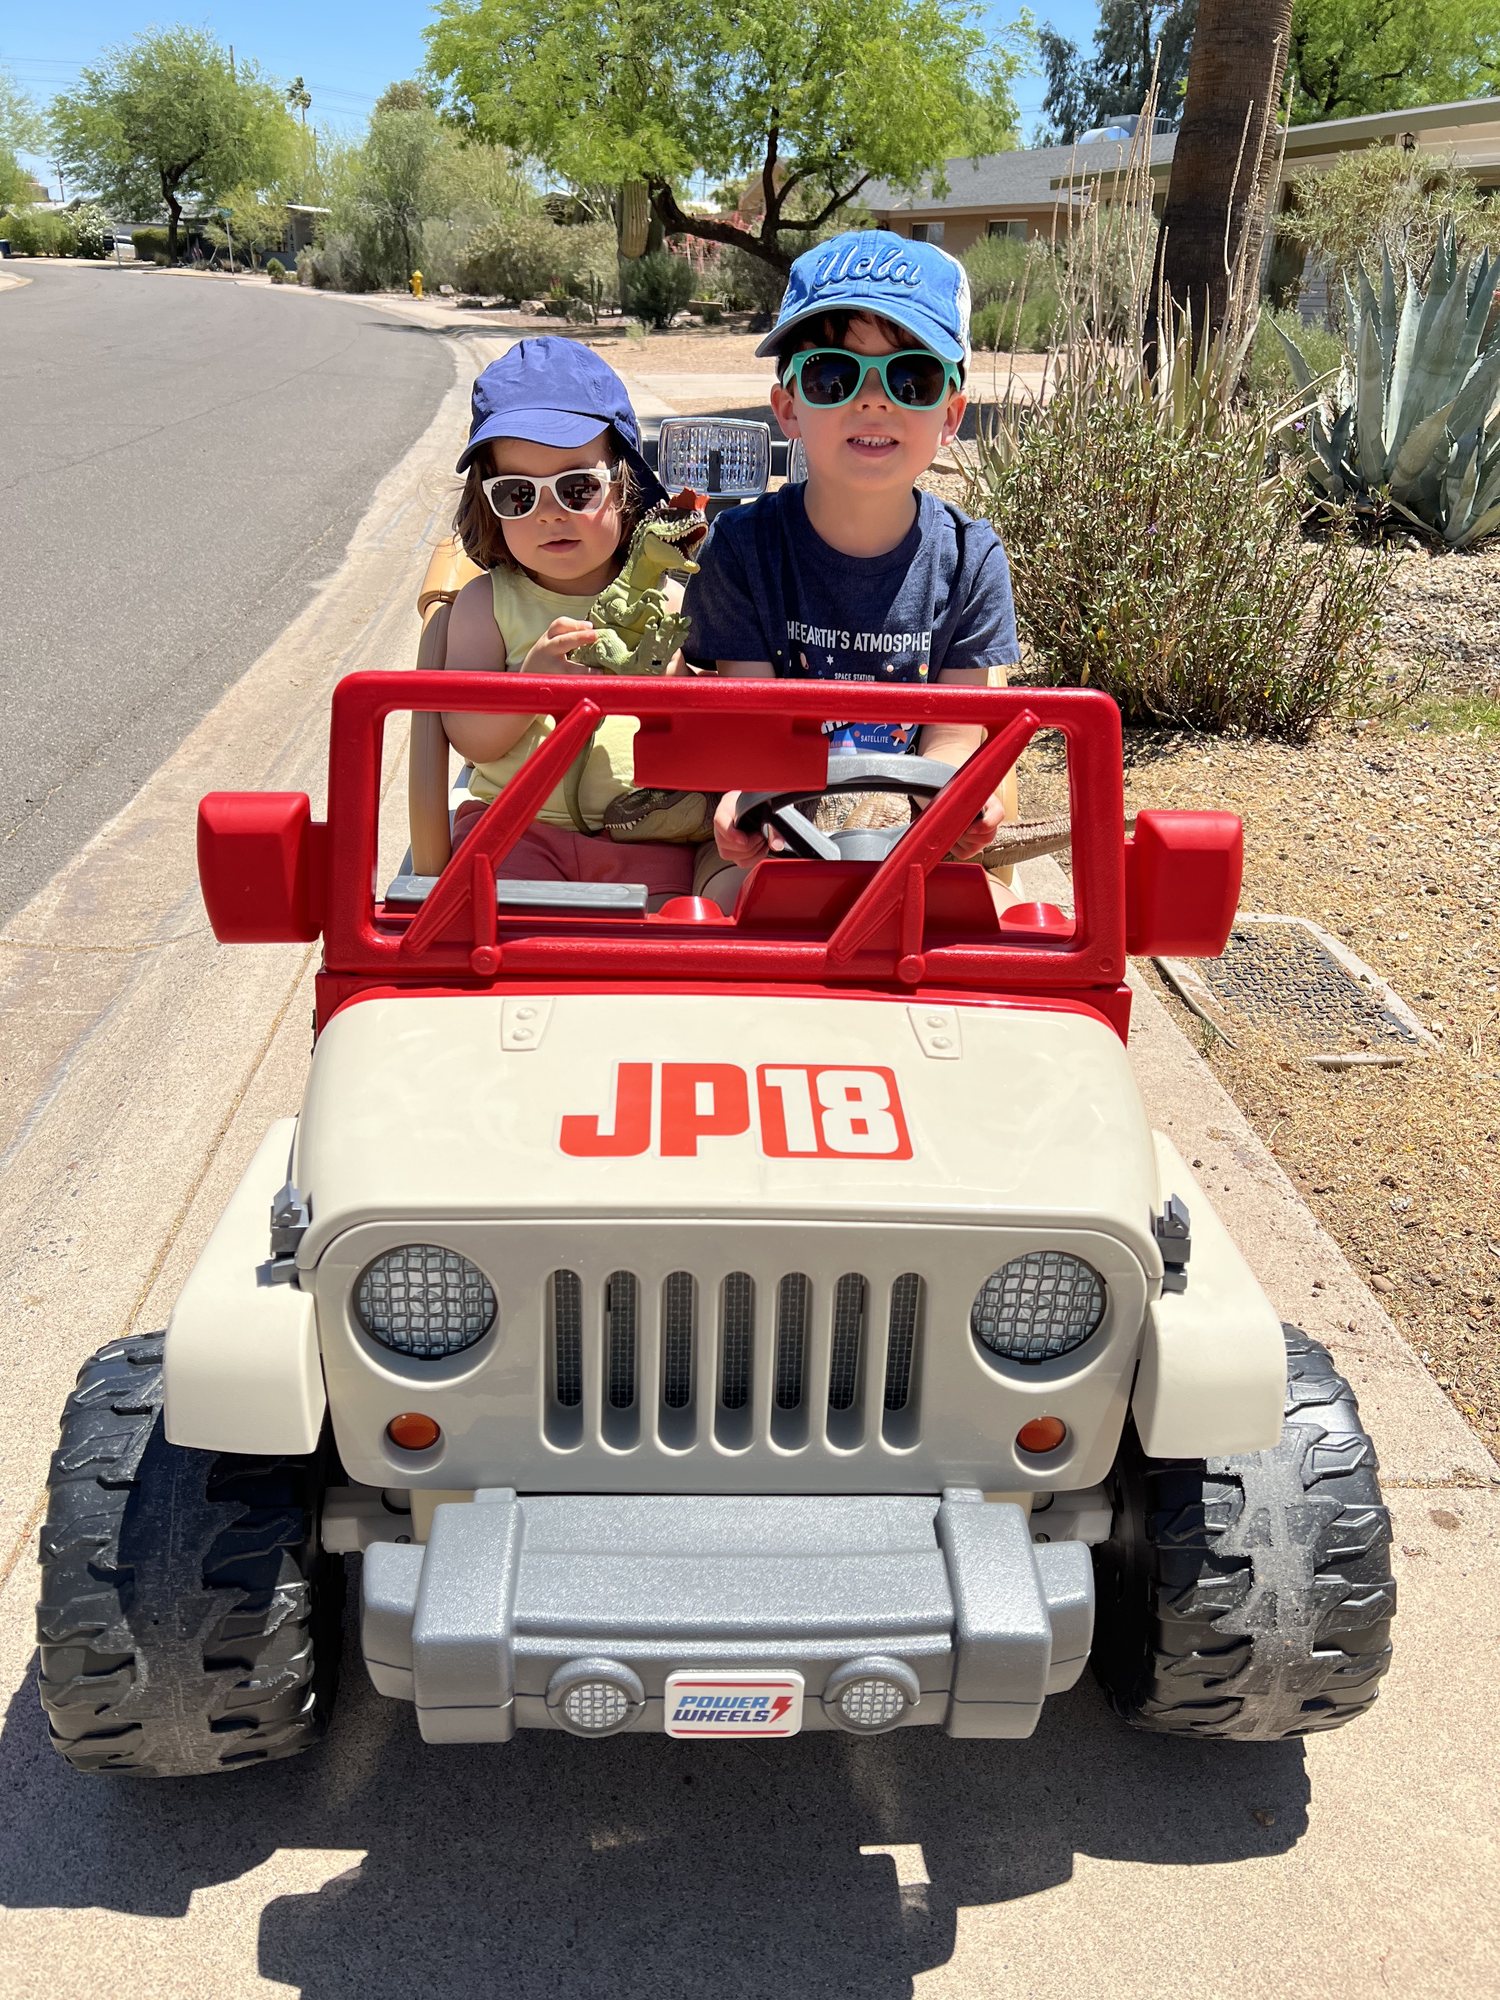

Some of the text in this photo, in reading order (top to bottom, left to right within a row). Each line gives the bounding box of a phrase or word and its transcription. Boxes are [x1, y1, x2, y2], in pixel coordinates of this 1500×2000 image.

[834, 672, 875, 681] SPACE STATION
[860, 735, 889, 744] SATELLITE
[678, 1696, 770, 1708] POWER
[672, 1709, 770, 1722] WHEELS
